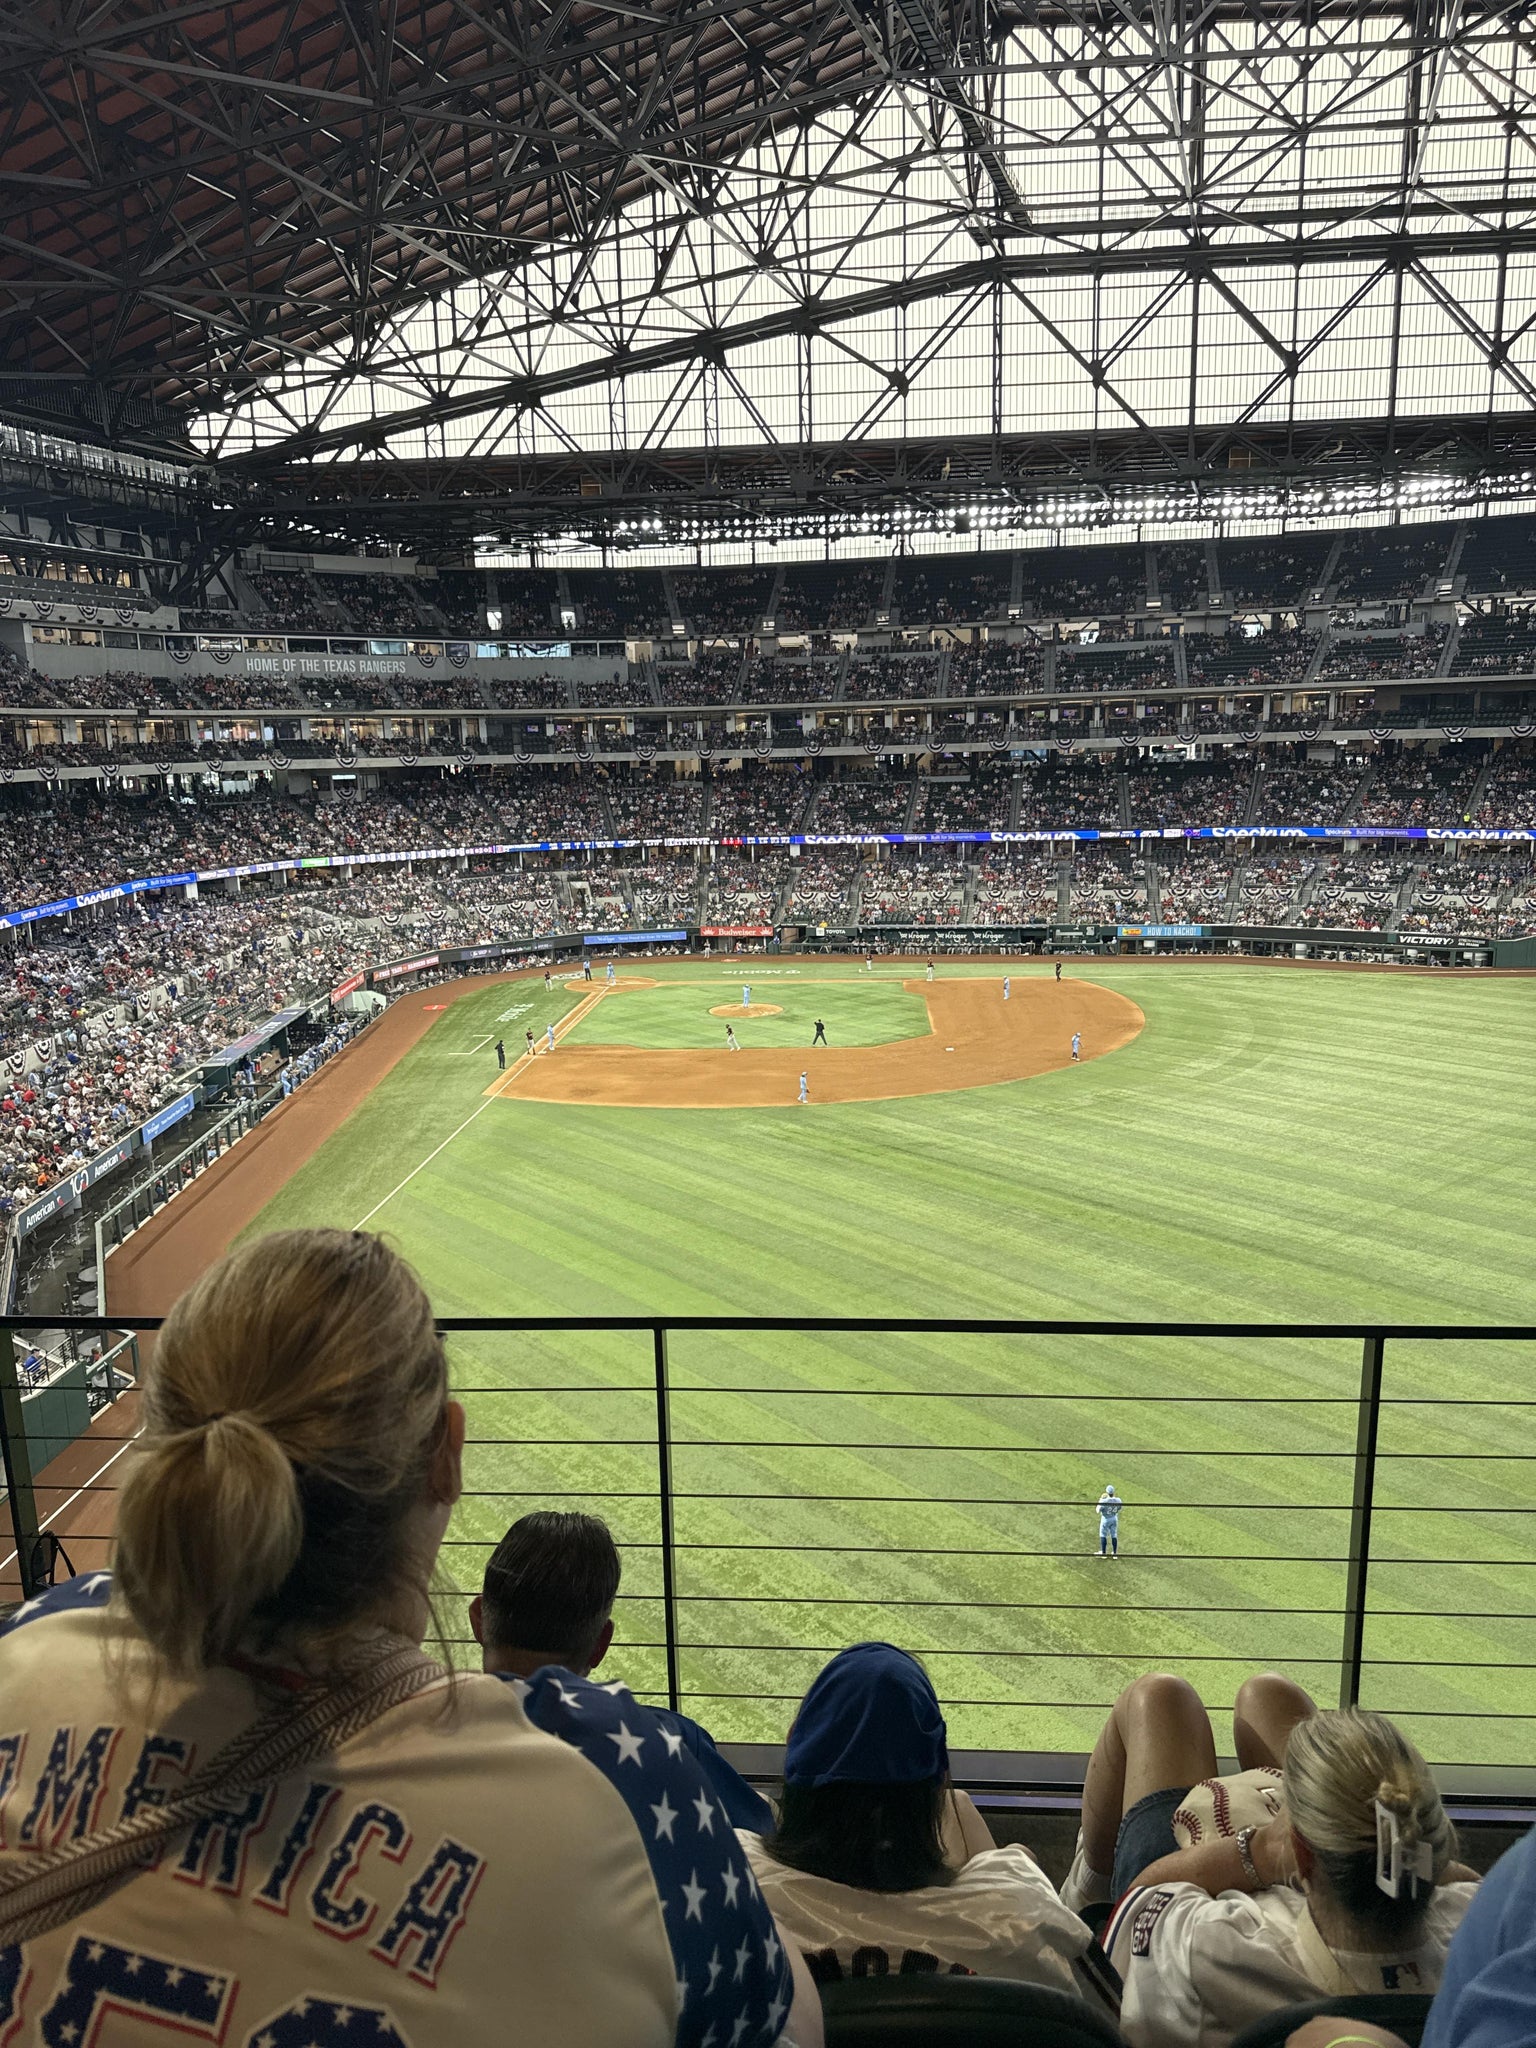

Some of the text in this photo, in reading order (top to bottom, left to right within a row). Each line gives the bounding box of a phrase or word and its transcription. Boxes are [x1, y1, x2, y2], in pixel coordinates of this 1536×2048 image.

[246, 658, 406, 673] HOME OF THE TEXAS RANGERS
[909, 931, 930, 942] Kroger
[982, 931, 1005, 942] Kroger
[1147, 926, 1163, 936] HOW
[1164, 926, 1172, 936] TO
[1173, 926, 1197, 936] NACHO!
[945, 931, 967, 943] Kroger
[1399, 935, 1451, 945] VICTORY
[94, 1153, 119, 1178] American
[26, 1200, 56, 1229] American
